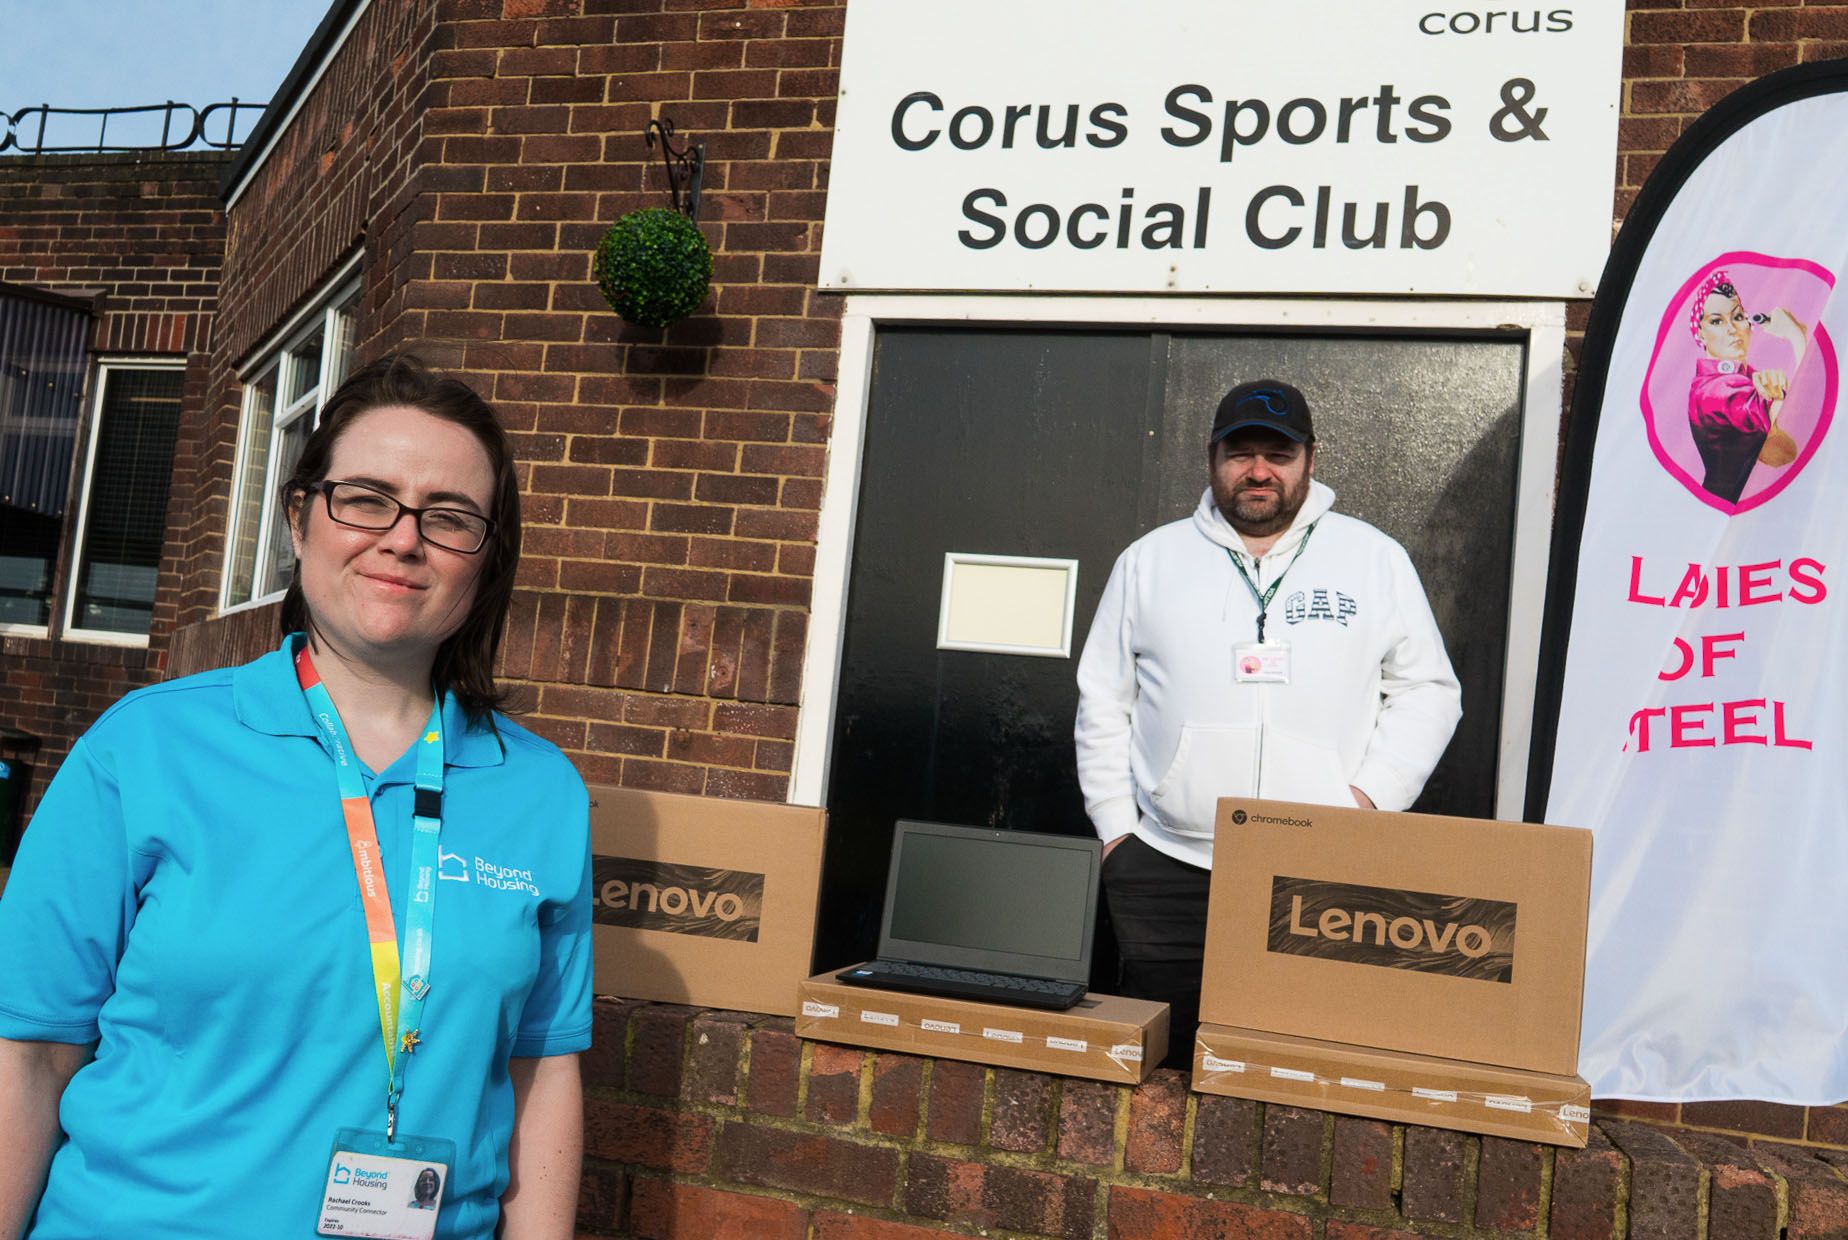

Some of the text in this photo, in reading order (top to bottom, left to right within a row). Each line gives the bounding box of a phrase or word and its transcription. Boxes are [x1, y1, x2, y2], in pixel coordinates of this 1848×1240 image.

[1419, 8, 1575, 35] corus
[890, 77, 1550, 163] Corus Sports &
[957, 185, 1454, 251] Social Club
[1285, 588, 1358, 628] GAP
[1250, 812, 1313, 828] chromebook
[474, 856, 533, 881] Beyond
[476, 871, 540, 897] Housing
[591, 879, 744, 922] enovo
[1289, 894, 1492, 958] Lenovo
[353, 1177, 387, 1190] Housing
[355, 1168, 387, 1179] Beyond
